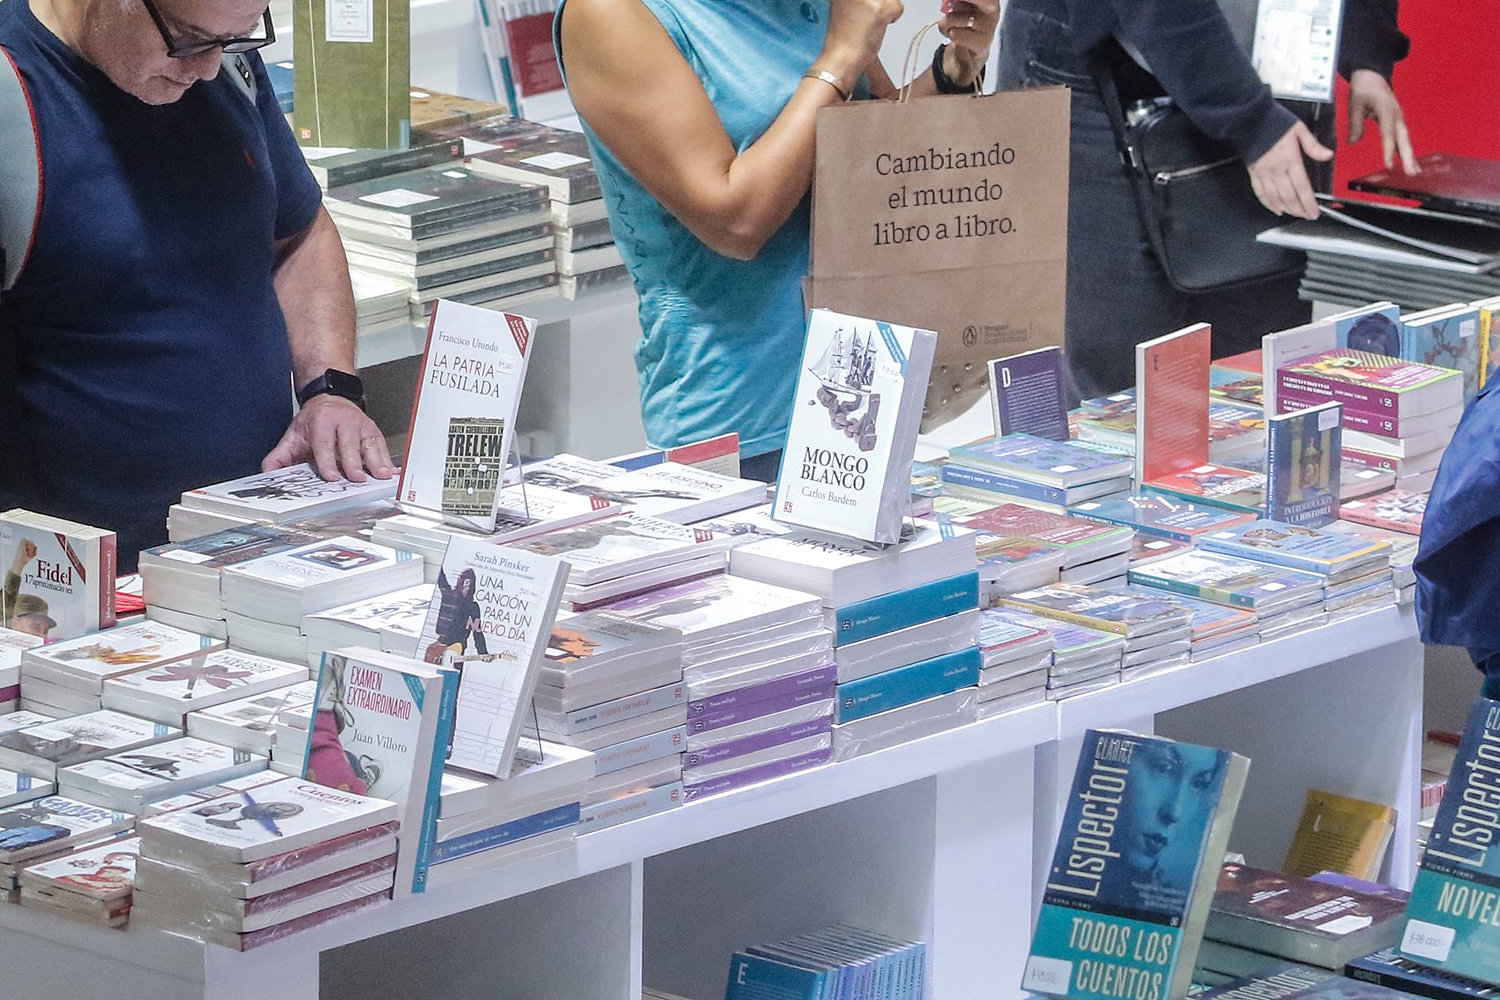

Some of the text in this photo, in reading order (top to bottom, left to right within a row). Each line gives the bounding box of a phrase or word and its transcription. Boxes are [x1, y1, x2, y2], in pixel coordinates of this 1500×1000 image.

[876, 142, 1015, 176] Cambiando
[888, 178, 1003, 209] el mundo
[873, 214, 1017, 246] libro a libro.
[438, 330, 499, 353] Francisco Urondo
[433, 352, 448, 369] LA
[452, 356, 495, 379] PATRIA
[430, 369, 500, 399] FUSILADA
[447, 434, 503, 457] TRELEW
[803, 446, 869, 475] MONGO
[800, 463, 866, 491] BLANCO
[801, 485, 826, 501] Carlos
[37, 559, 73, 586] Fidel
[474, 552, 498, 566] Sarah
[500, 557, 530, 573] Pinsker
[25, 573, 34, 584] 17
[480, 575, 504, 591] UNA
[475, 589, 529, 611] CANCIÓN
[465, 616, 526, 642] NUEVO DÍA
[484, 606, 532, 628] PARA UN
[350, 665, 383, 692] EXAMEN
[346, 686, 412, 721] EXTRAORDINARIO
[352, 729, 408, 753] Juan Villoro
[296, 785, 366, 806] Cuentos
[1047, 759, 1129, 897] Lispector
[1436, 881, 1500, 928] NOVEL
[1068, 917, 1174, 966] TODOS LOS
[1076, 959, 1163, 1000] CUENTOS
